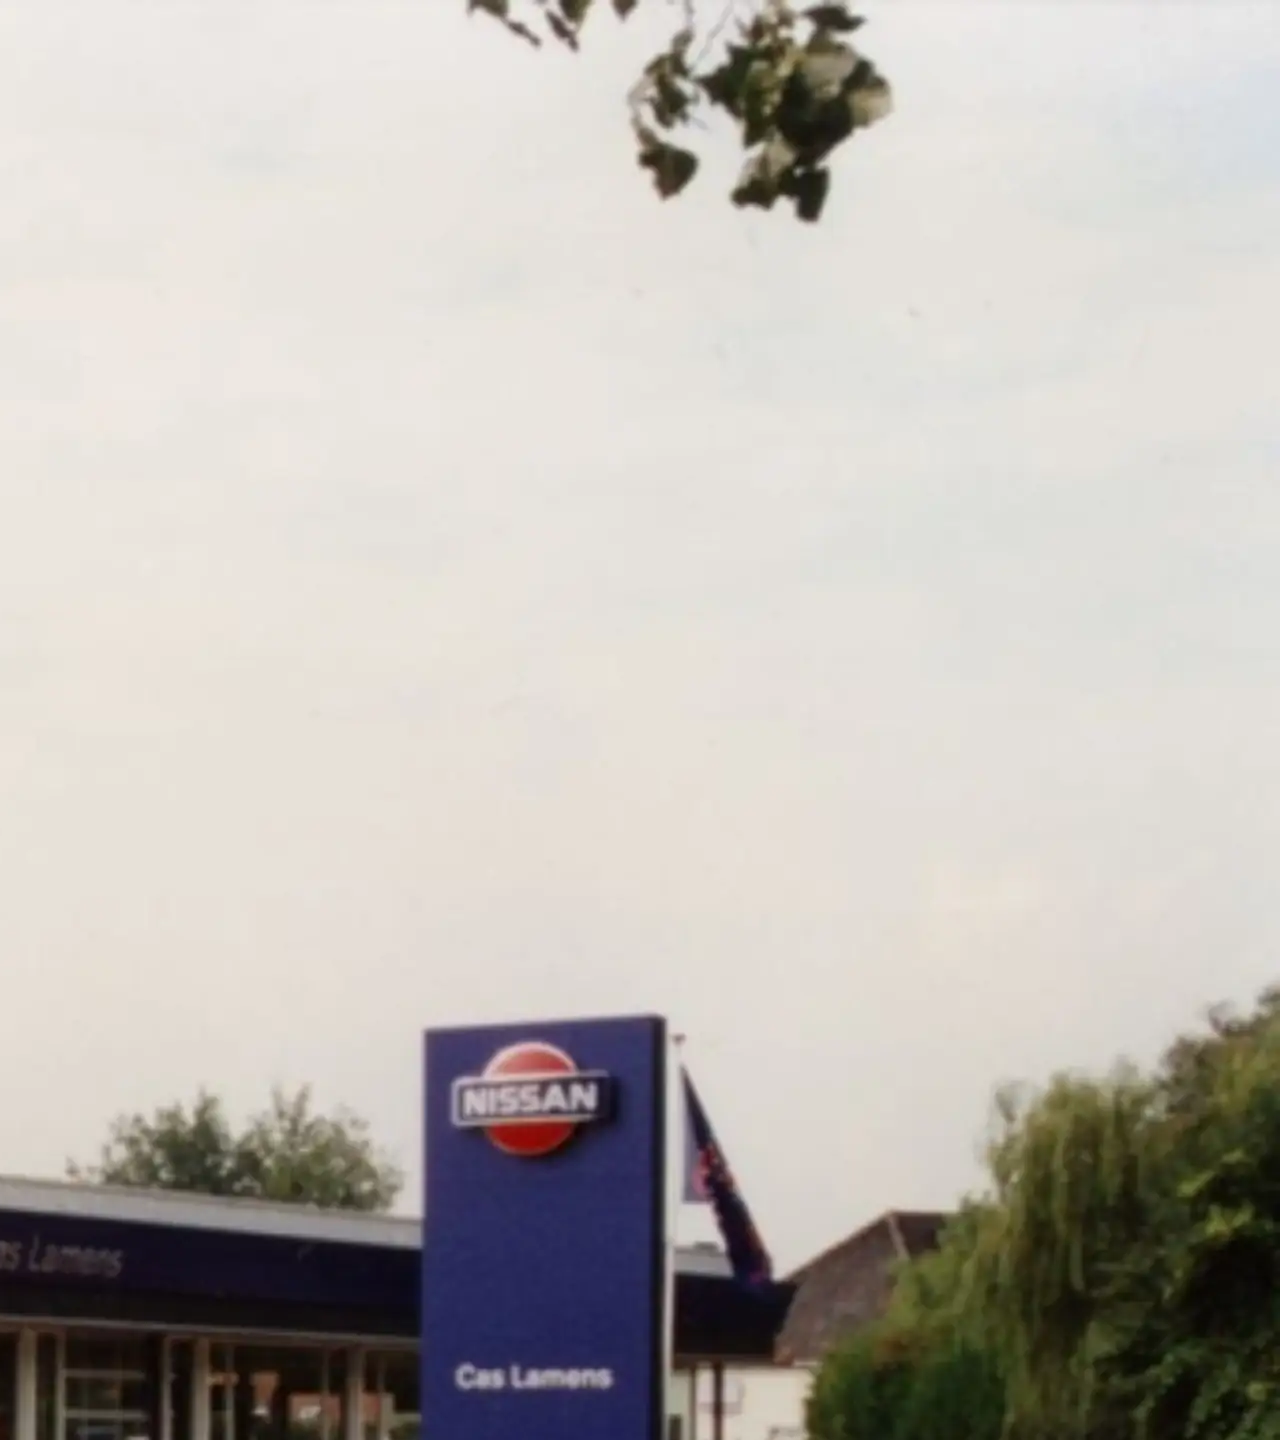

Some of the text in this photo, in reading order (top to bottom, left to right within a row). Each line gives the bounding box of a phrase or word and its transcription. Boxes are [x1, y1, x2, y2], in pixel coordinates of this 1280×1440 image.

[463, 1082, 598, 1118] NISSAN
[28, 1235, 123, 1278] Lamens
[456, 1363, 613, 1389] Cas Lamens
